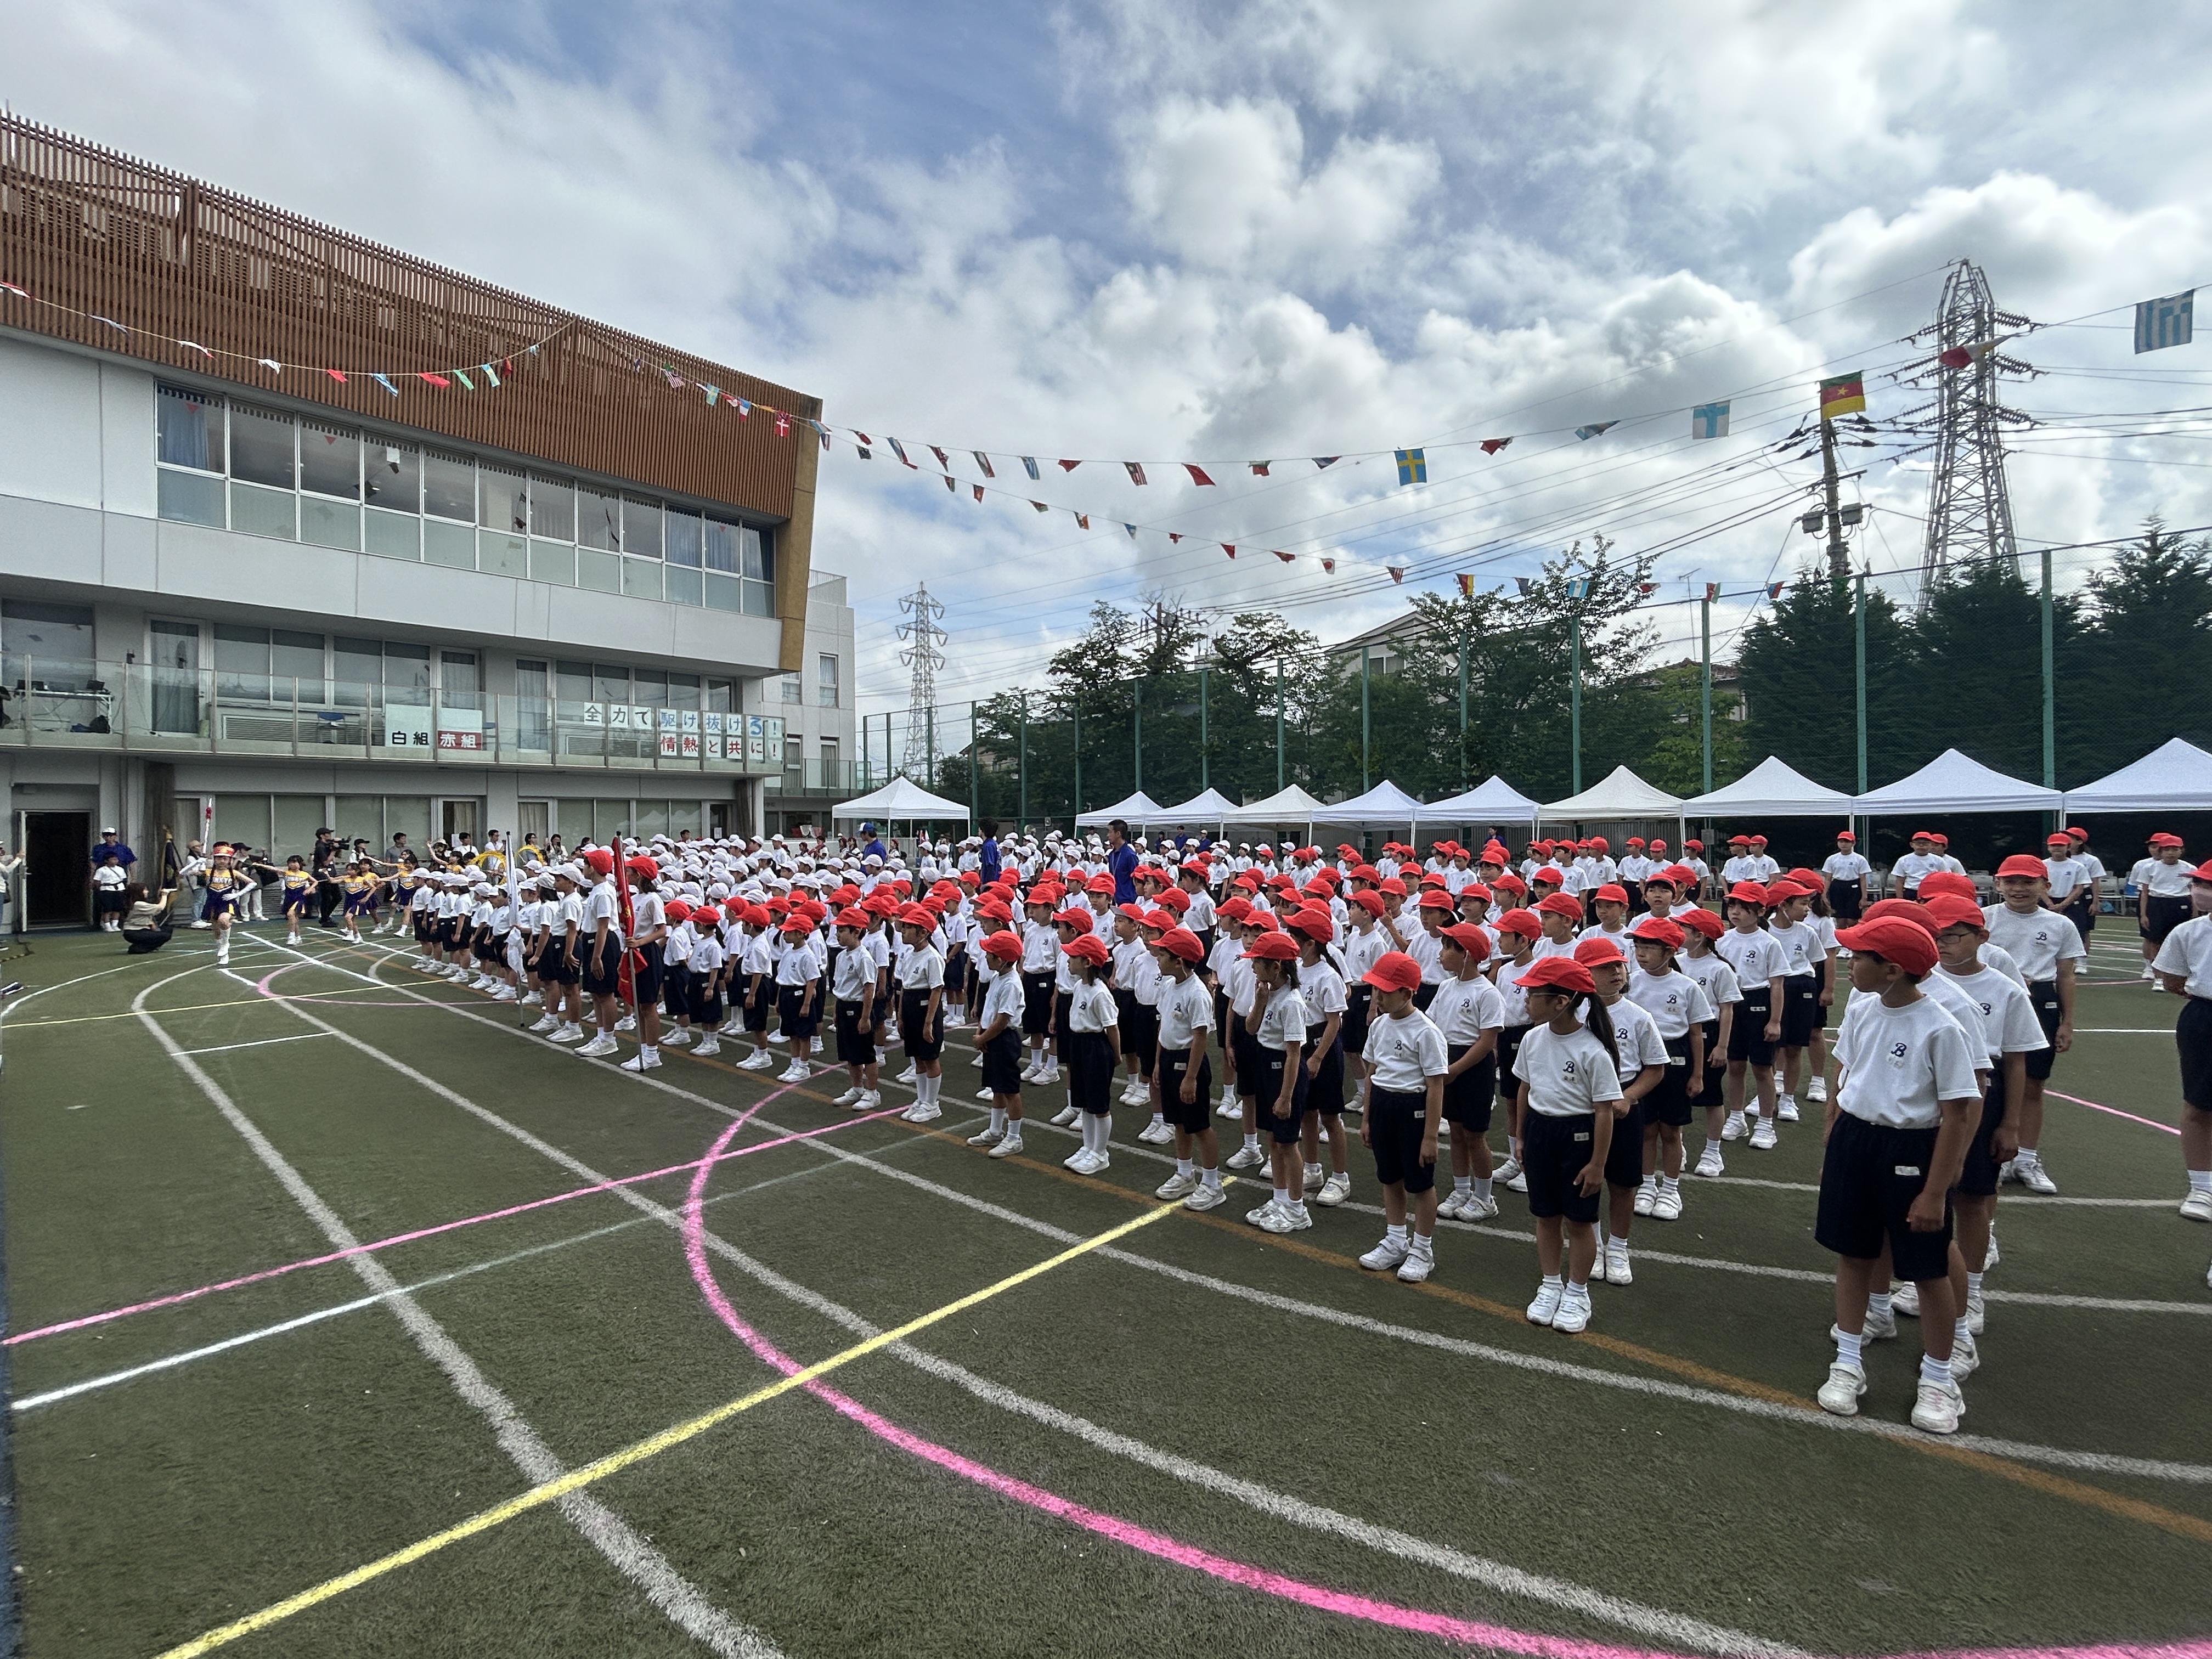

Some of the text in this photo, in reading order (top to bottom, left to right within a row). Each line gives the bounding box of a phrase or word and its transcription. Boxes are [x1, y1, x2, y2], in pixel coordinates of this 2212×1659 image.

[392, 731, 430, 746] 白組
[440, 733, 477, 748] 赤組
[2035, 932, 2047, 940] B
[1698, 977, 1706, 985] B
[1461, 998, 1470, 1007] B
[1667, 994, 1677, 1003] B
[1079, 1001, 1087, 1009] B
[1266, 1011, 1273, 1020] B
[1616, 1028, 1628, 1039] B
[1395, 1040, 1402, 1050] B
[1891, 1043, 1906, 1057] B
[1563, 1061, 1575, 1073] B
